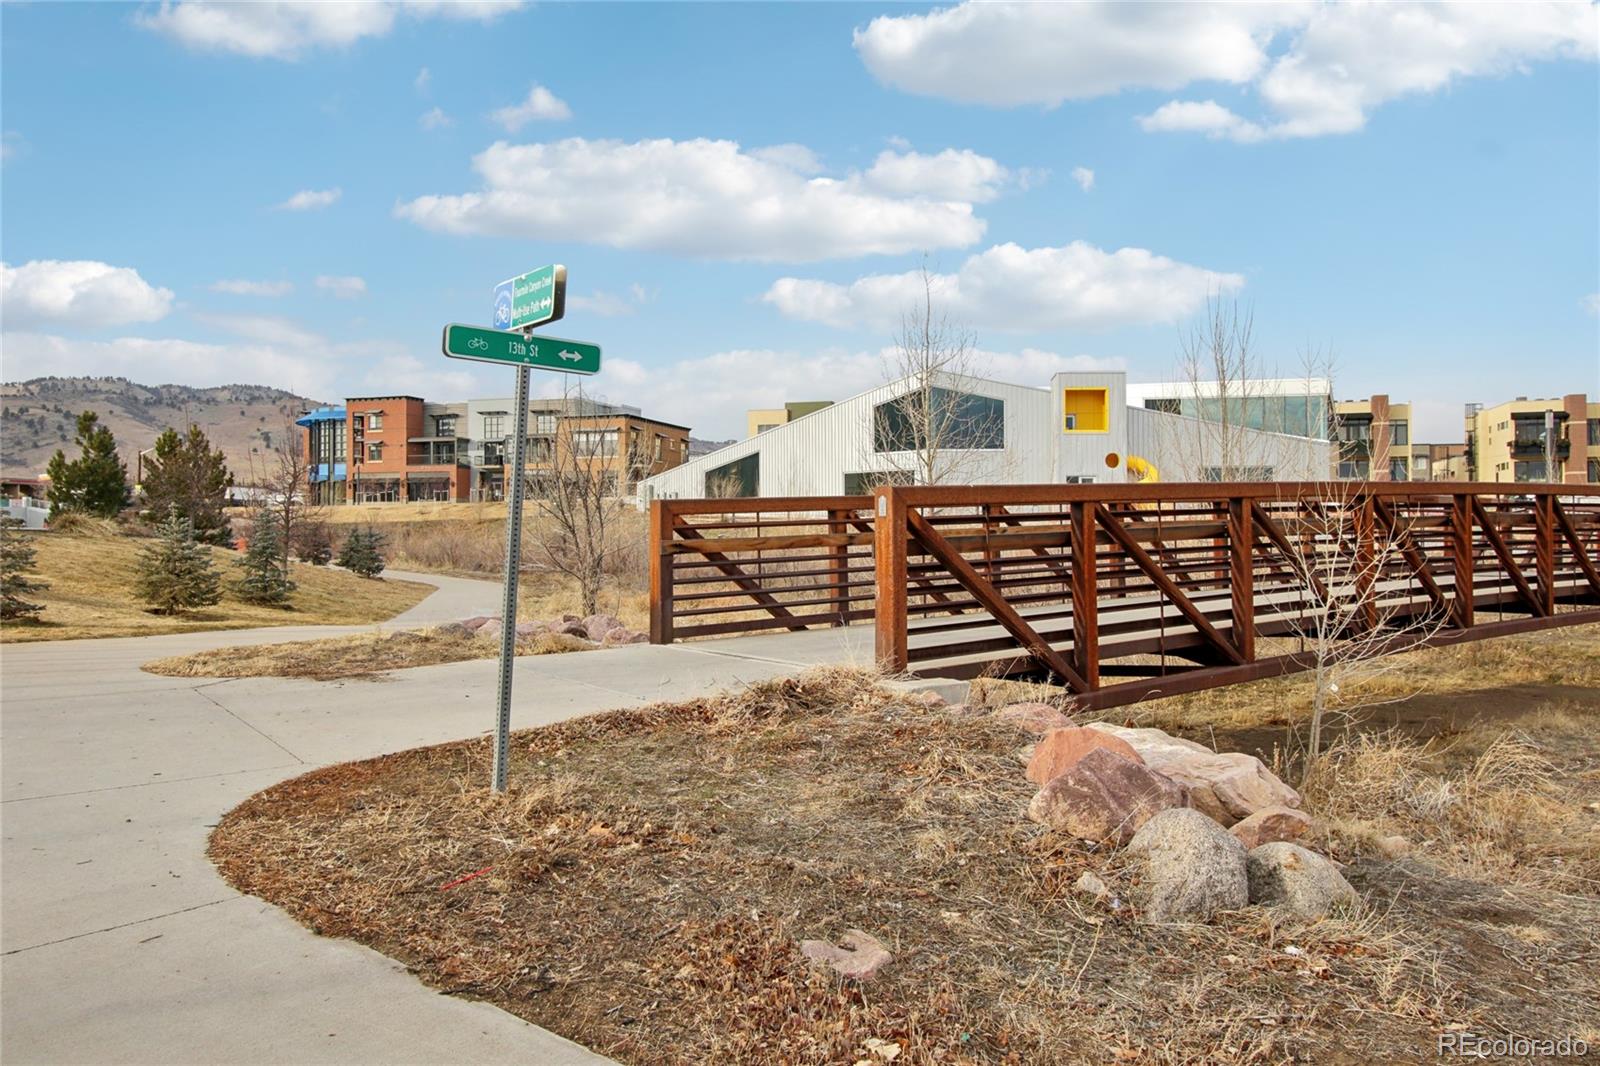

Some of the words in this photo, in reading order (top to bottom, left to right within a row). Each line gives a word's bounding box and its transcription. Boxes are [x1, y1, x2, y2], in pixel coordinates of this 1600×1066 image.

[530, 301, 540, 313] Path
[508, 341, 526, 355] 13th
[529, 344, 539, 357] St
